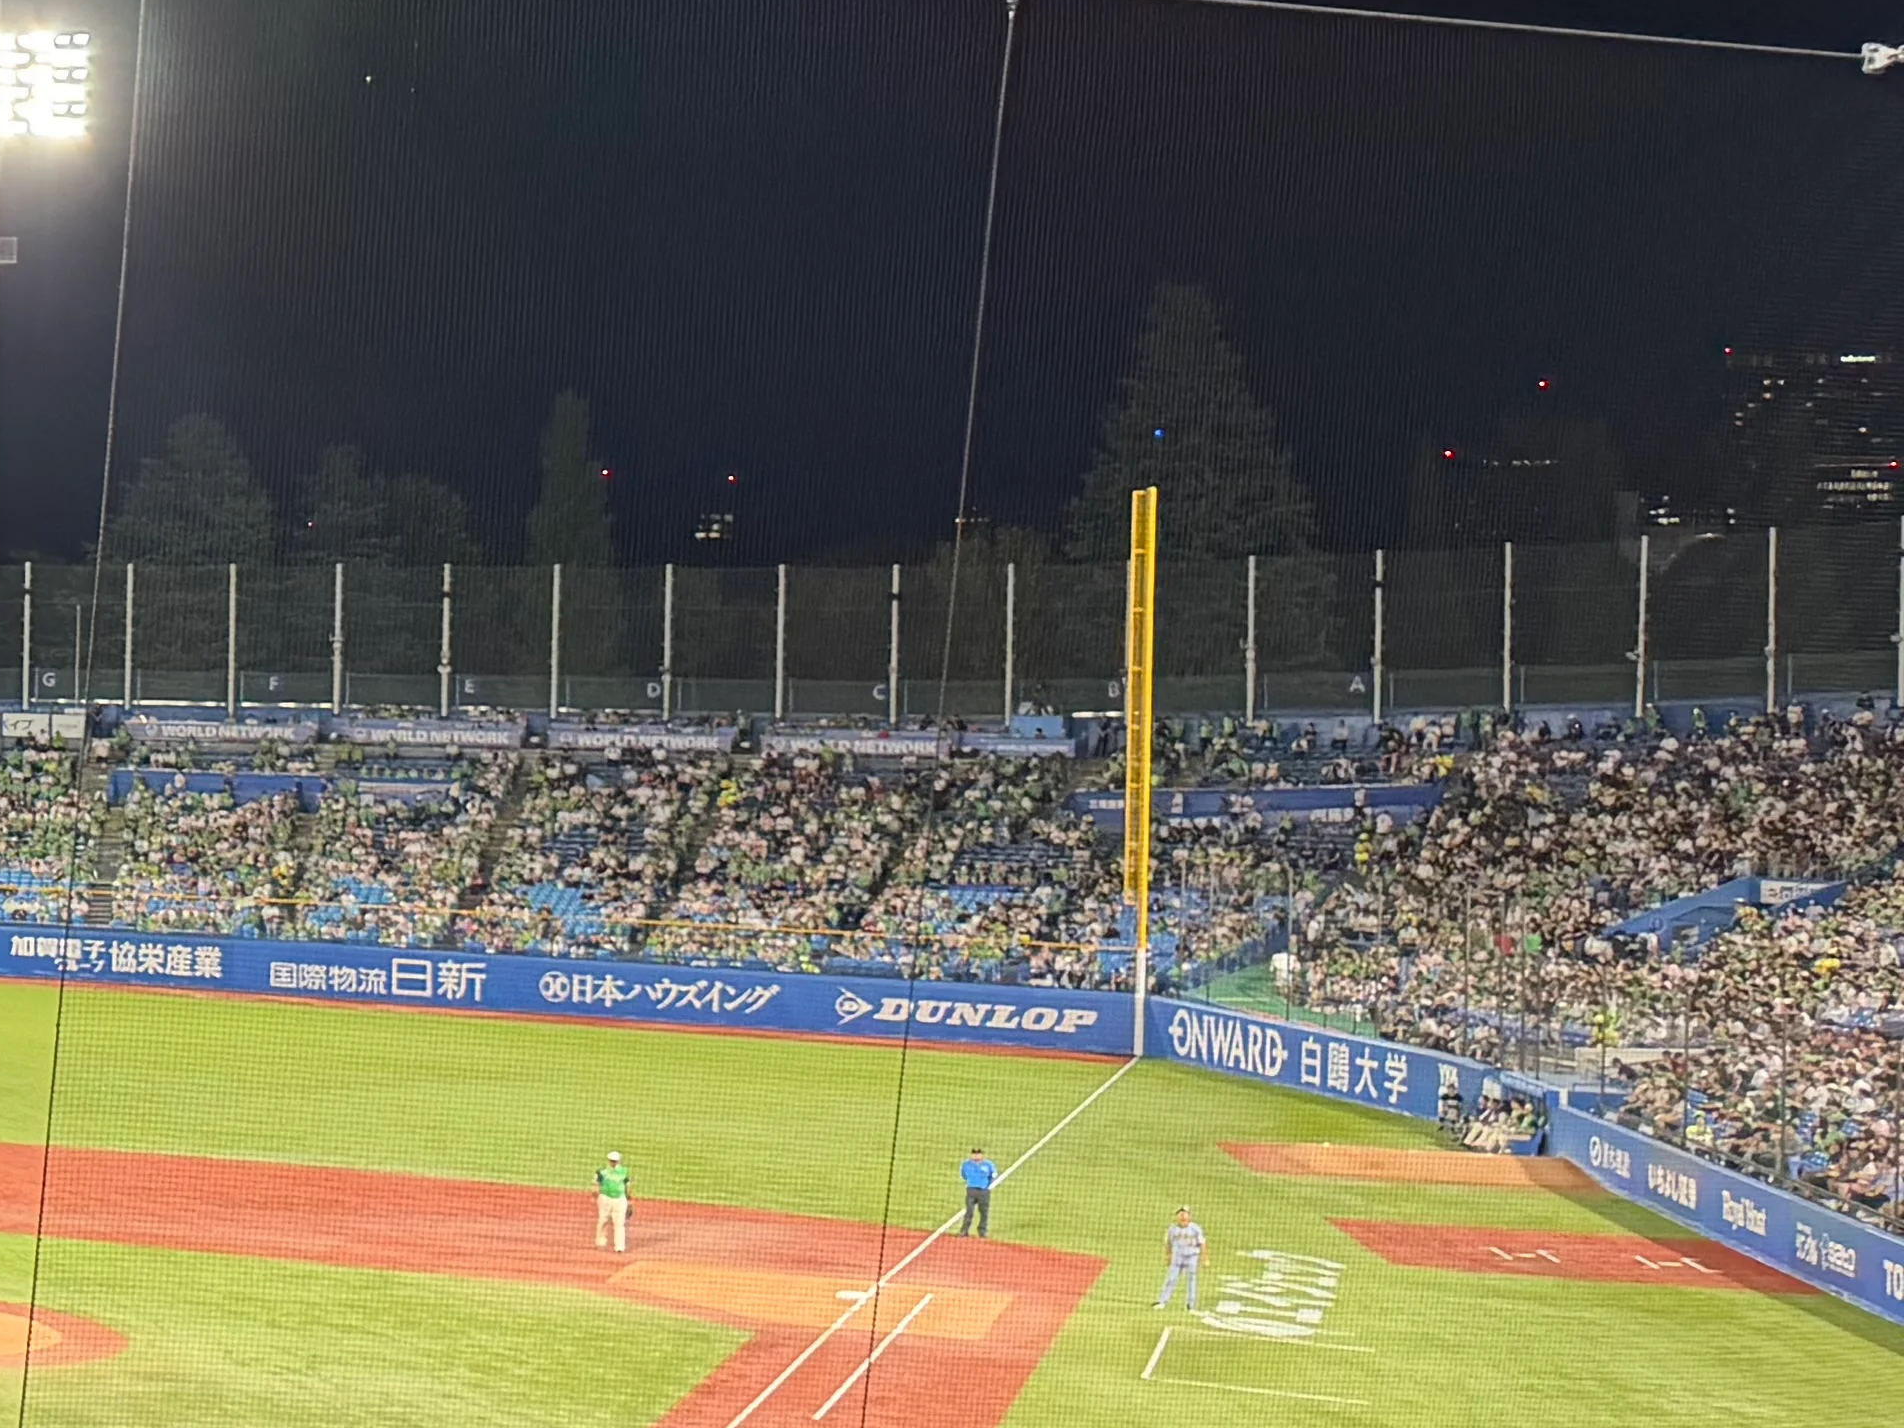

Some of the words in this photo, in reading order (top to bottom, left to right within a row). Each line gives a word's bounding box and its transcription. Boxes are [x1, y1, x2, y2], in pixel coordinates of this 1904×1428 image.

[161, 723, 218, 739] WORLD
[219, 724, 294, 741] NETWORK
[108, 938, 224, 978] 協栄産業
[268, 960, 388, 996] 国際物流
[391, 957, 488, 1002] 日新
[569, 971, 781, 1014] 日本ハウズイング
[872, 995, 1098, 1034] DUNLOP
[1167, 1008, 1288, 1078] ONWARD
